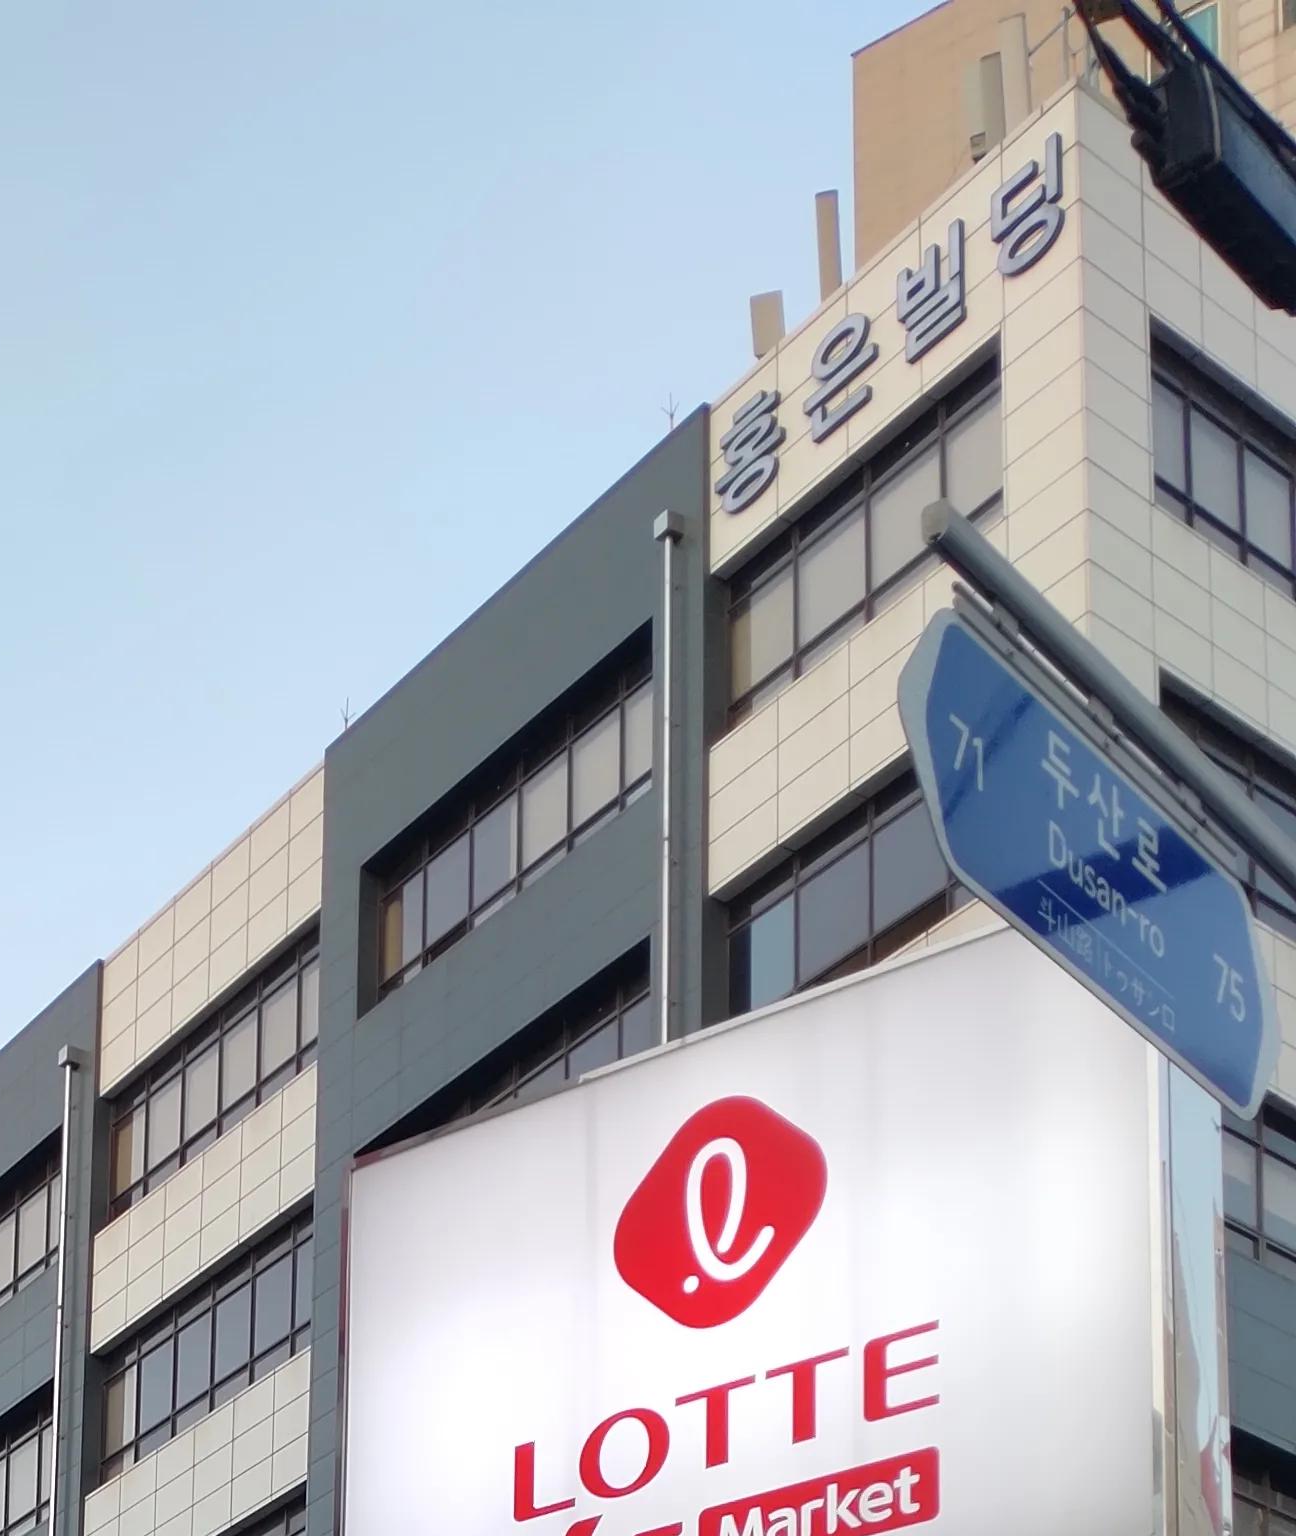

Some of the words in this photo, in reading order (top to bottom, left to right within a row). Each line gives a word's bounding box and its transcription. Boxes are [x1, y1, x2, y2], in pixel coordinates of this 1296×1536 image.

[948, 713, 984, 792] 71
[1041, 729, 1167, 894] 두산로
[1047, 819, 1165, 959] Dusan-ro
[1213, 952, 1246, 1023] 75
[514, 1320, 940, 1523] LOTTE
